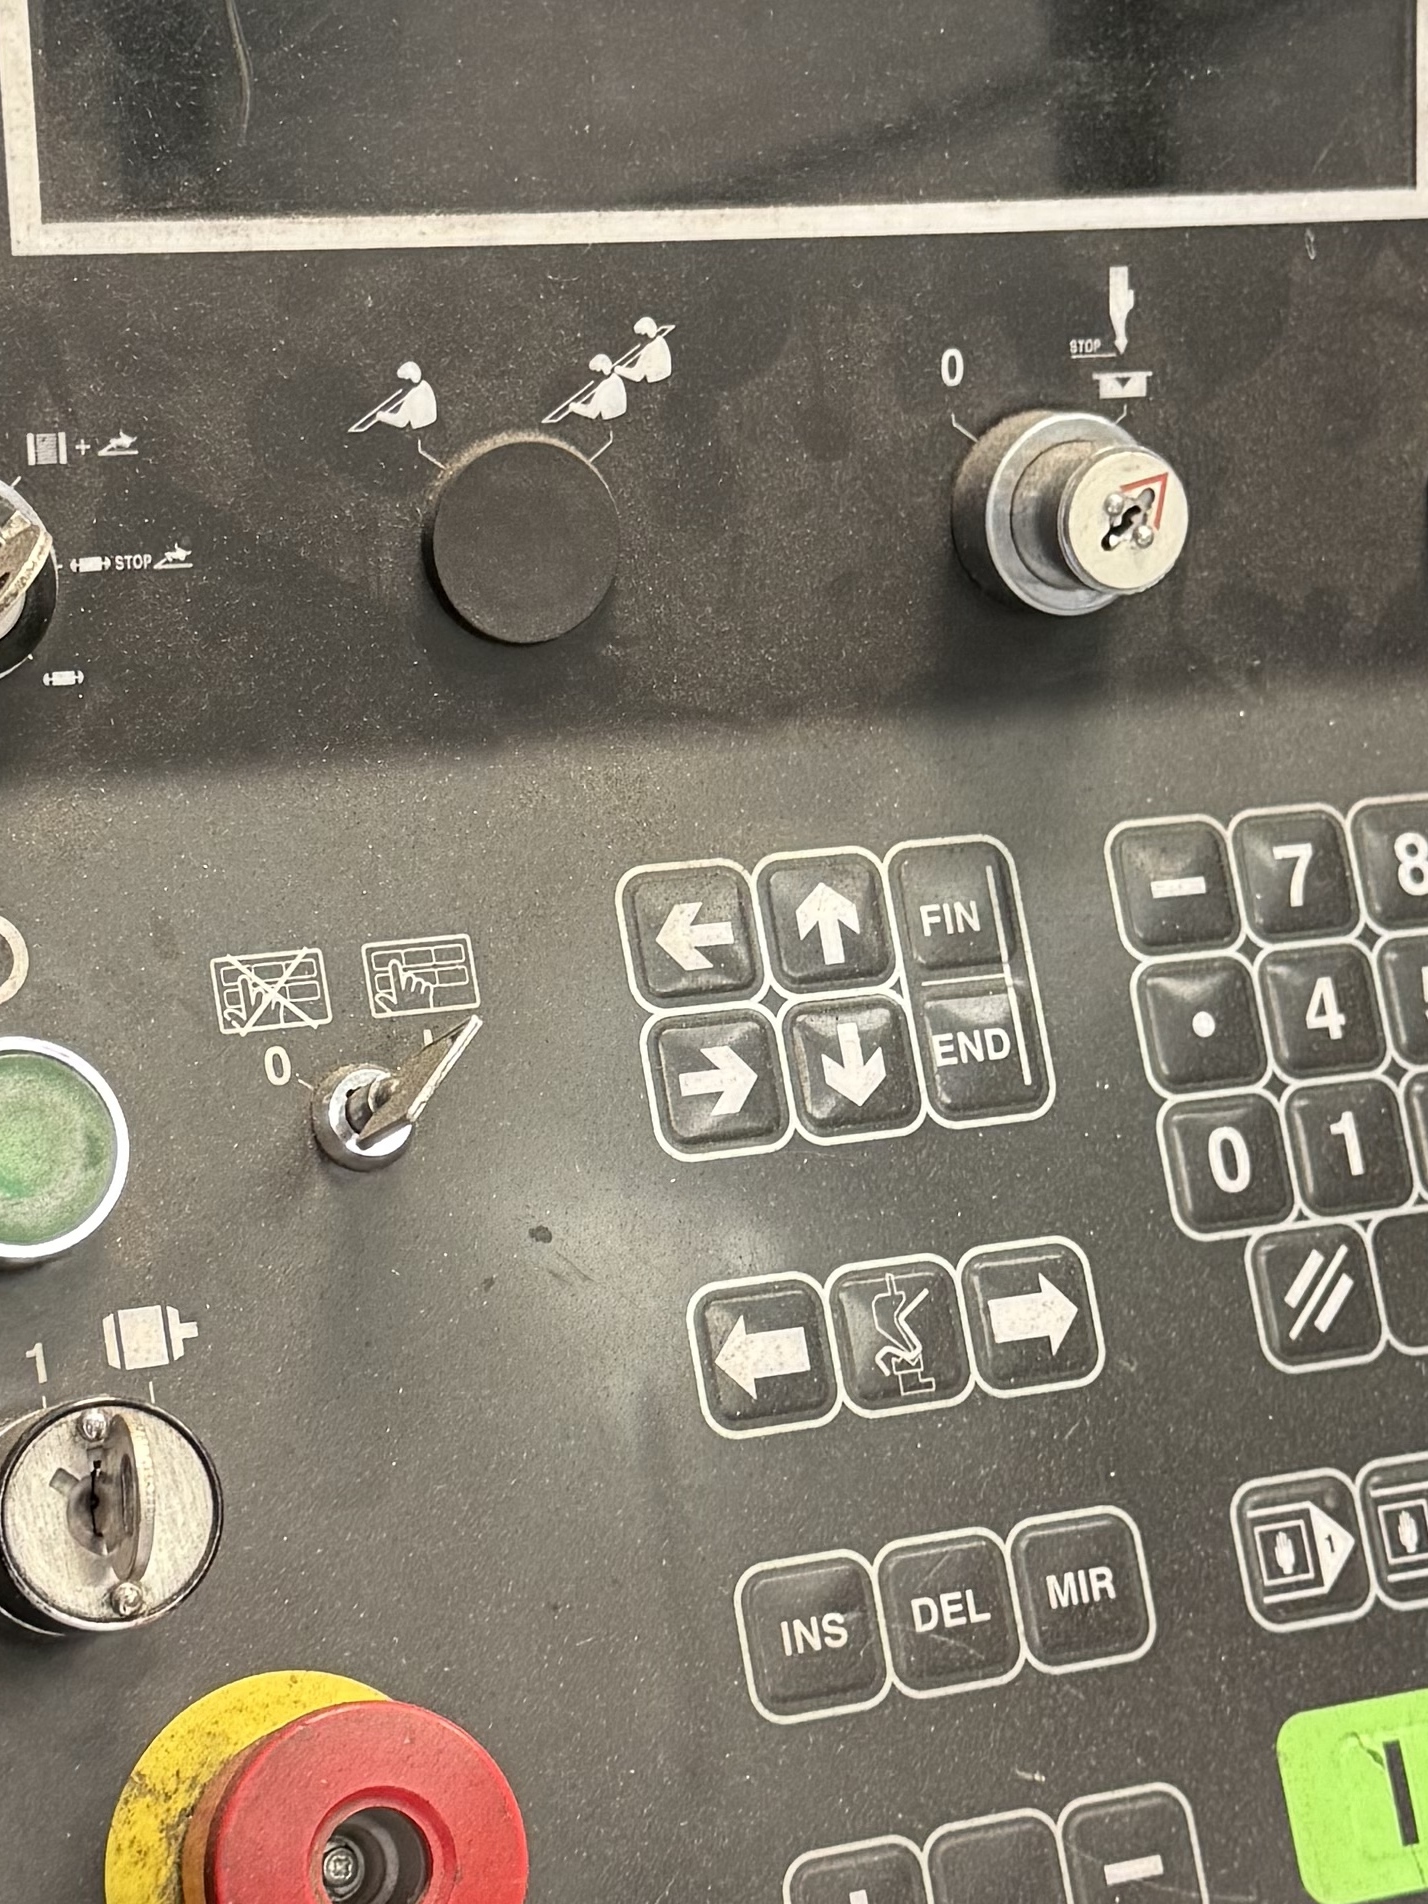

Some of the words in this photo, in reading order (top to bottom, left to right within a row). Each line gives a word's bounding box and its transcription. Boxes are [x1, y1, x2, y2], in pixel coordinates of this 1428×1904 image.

[940, 347, 964, 387] 0
[1069, 338, 1102, 355] STOP
[114, 553, 153, 571] STOP
[1272, 842, 1313, 908] 7
[918, 900, 982, 938] FIN
[1305, 975, 1346, 1040] 4
[263, 1044, 293, 1087] 0
[932, 1032, 1012, 1069] END
[1207, 1126, 1252, 1194] 0
[1330, 1111, 1366, 1176] 1
[24, 1341, 49, 1385] 1
[1323, 1533, 1336, 1555] 1
[779, 1612, 850, 1657] INS
[910, 1589, 992, 1633] DEL
[1045, 1565, 1117, 1610] MIR
